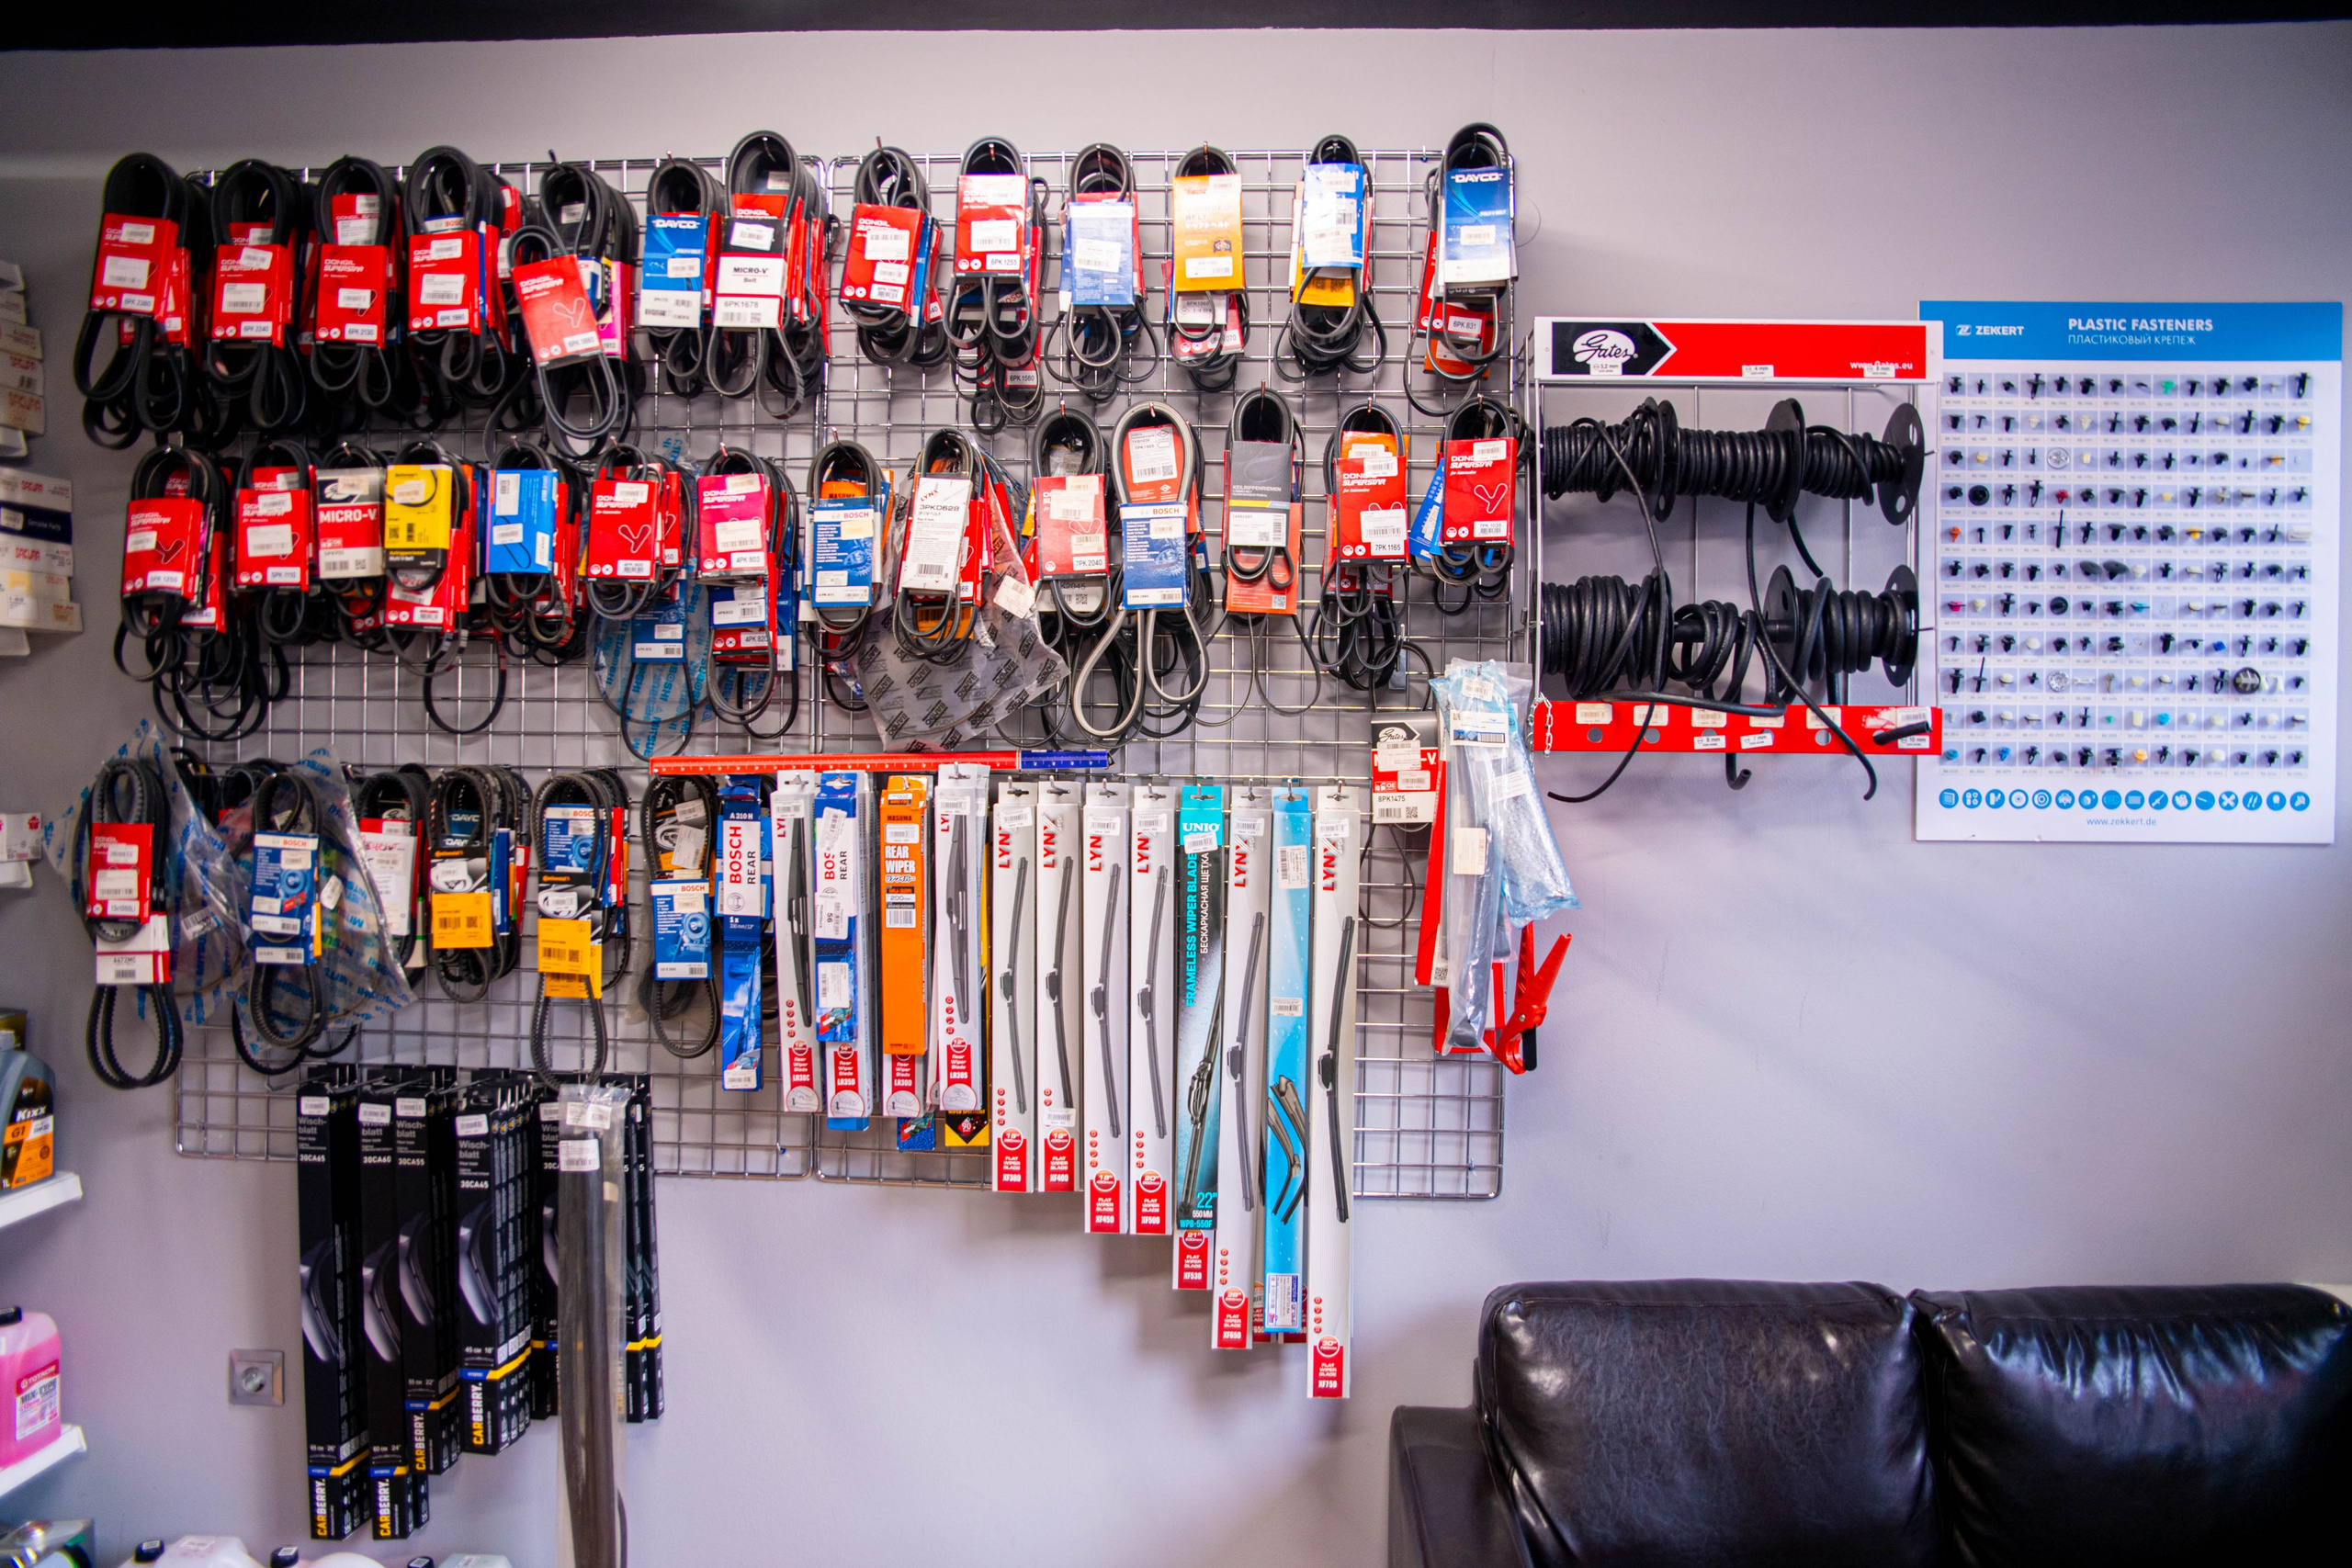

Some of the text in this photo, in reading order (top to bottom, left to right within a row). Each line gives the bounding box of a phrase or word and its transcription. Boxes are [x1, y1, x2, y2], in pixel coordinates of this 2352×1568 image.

[1455, 173, 1499, 183] DAYCO
[654, 220, 697, 229] DAYCO
[2068, 318, 2214, 332] PLASTIC FASTENERS
[1976, 326, 2024, 335] ZEKKERT
[2068, 333, 2197, 345] ПЛАСТИКОВЫЙ КРЕПЕЖ
[1575, 334, 1634, 361] Gates
[919, 504, 960, 513] 3PK0628
[1152, 507, 1180, 515] BOSCH
[319, 508, 377, 523] MICRO-V
[843, 511, 869, 519] BOSCH
[1075, 558, 1103, 567] 7PK 2040
[1377, 795, 1406, 803] 8PK1475
[2086, 816, 2156, 827] www.zekkert.de
[1182, 822, 1219, 832] UNIO
[885, 845, 910, 859] REAR
[999, 826, 1011, 869] LYN
[729, 826, 742, 884] BOSCH
[1090, 834, 1102, 872] LYN
[1137, 832, 1149, 874] LYN
[747, 851, 756, 885] REAR
[840, 851, 848, 880] REAR
[885, 860, 916, 874] WIPER
[681, 884, 706, 893] BOSCH
[1200, 852, 1209, 954] БЕСКАРКАСНАЯ ЩЕТКА
[1186, 852, 1198, 1007] FRAMELESS WIPER BLADE
[792, 1074, 810, 1082] LR30C
[298, 1117, 327, 1125] Wisch-
[396, 1121, 425, 1129] Wisch-
[298, 1126, 317, 1134] blatt
[961, 1122, 972, 1130] 90
[11, 1126, 26, 1138] G1
[362, 1128, 383, 1136] blatt
[396, 1129, 416, 1138] blatt
[459, 1140, 490, 1149] Wisch-
[459, 1150, 480, 1159] blatt
[1049, 1174, 1069, 1182] XF400
[1196, 1191, 1218, 1209] 22"
[1095, 1215, 1114, 1224] XF450
[1141, 1216, 1160, 1224] XF500
[1180, 1219, 1213, 1228] WPB-550F
[1183, 1271, 1202, 1280] XF530
[1223, 1331, 1241, 1339] XF650
[1318, 1380, 1337, 1388] XF750
[471, 1382, 484, 1445] CARBERRY.
[315, 1478, 327, 1537] CARBERRY.
[379, 1478, 390, 1537] CARBERRY.
